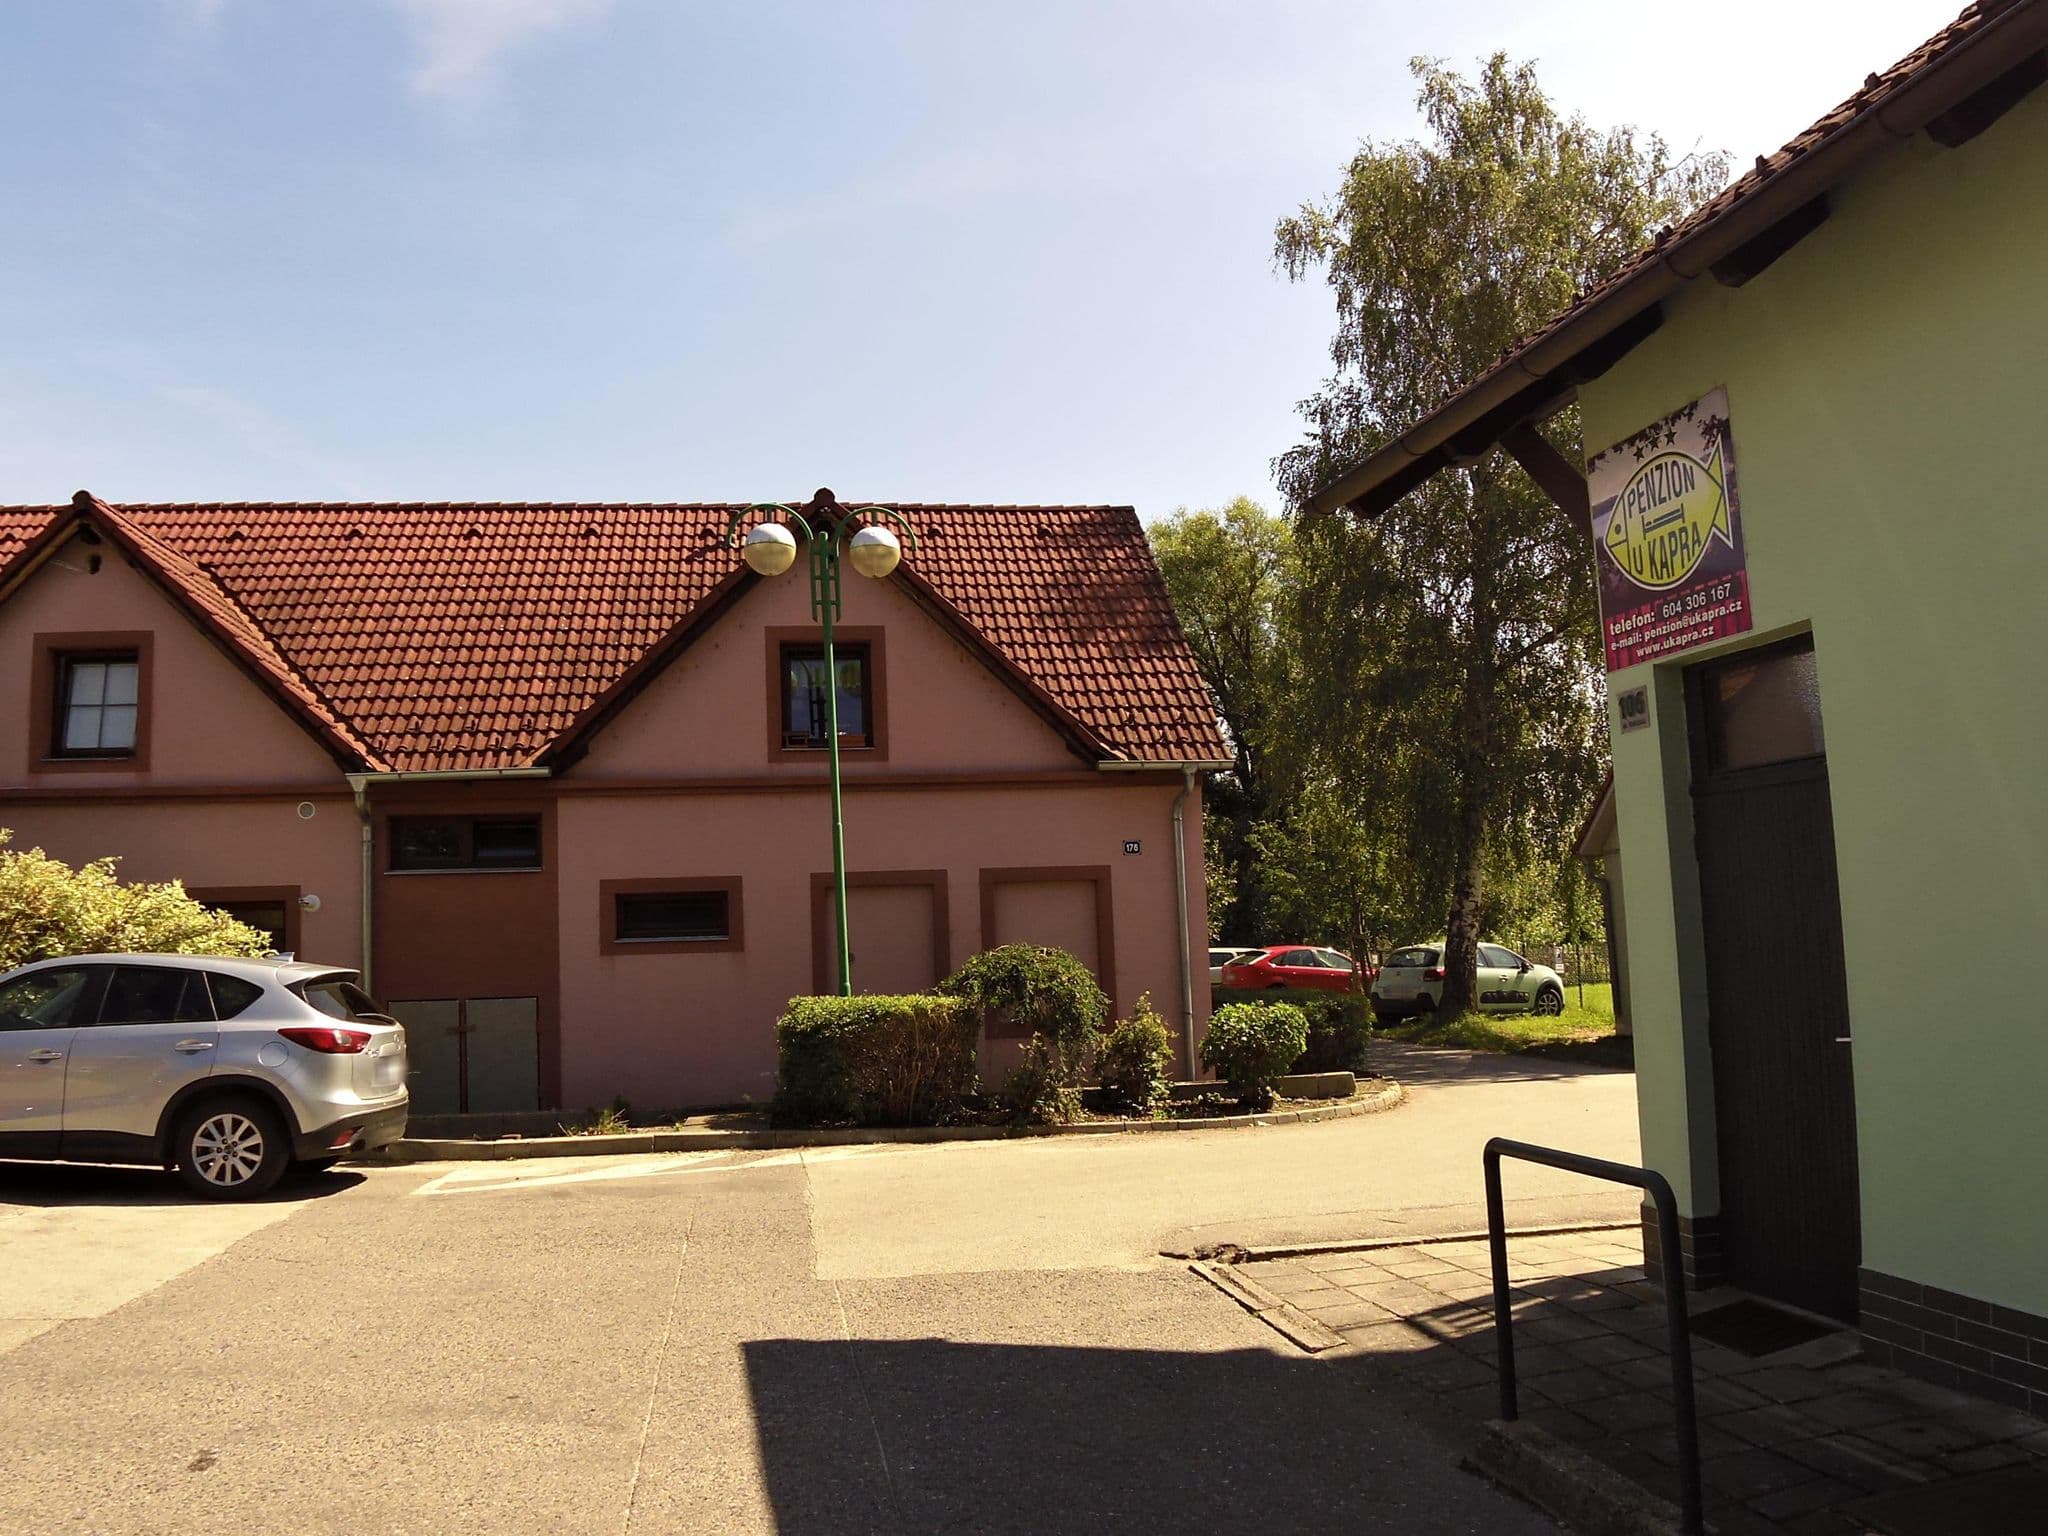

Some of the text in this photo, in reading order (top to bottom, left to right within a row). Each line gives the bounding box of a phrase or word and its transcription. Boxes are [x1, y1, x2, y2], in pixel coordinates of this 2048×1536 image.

[1627, 460, 1695, 518] PENZION
[1632, 521, 1701, 580] U KAPRA
[1610, 583, 1731, 635] telefon: 604 306 167
[1610, 600, 1742, 651] e-mail: penzion@ukapra.cz
[1636, 625, 1715, 657] www.ukapra.cz
